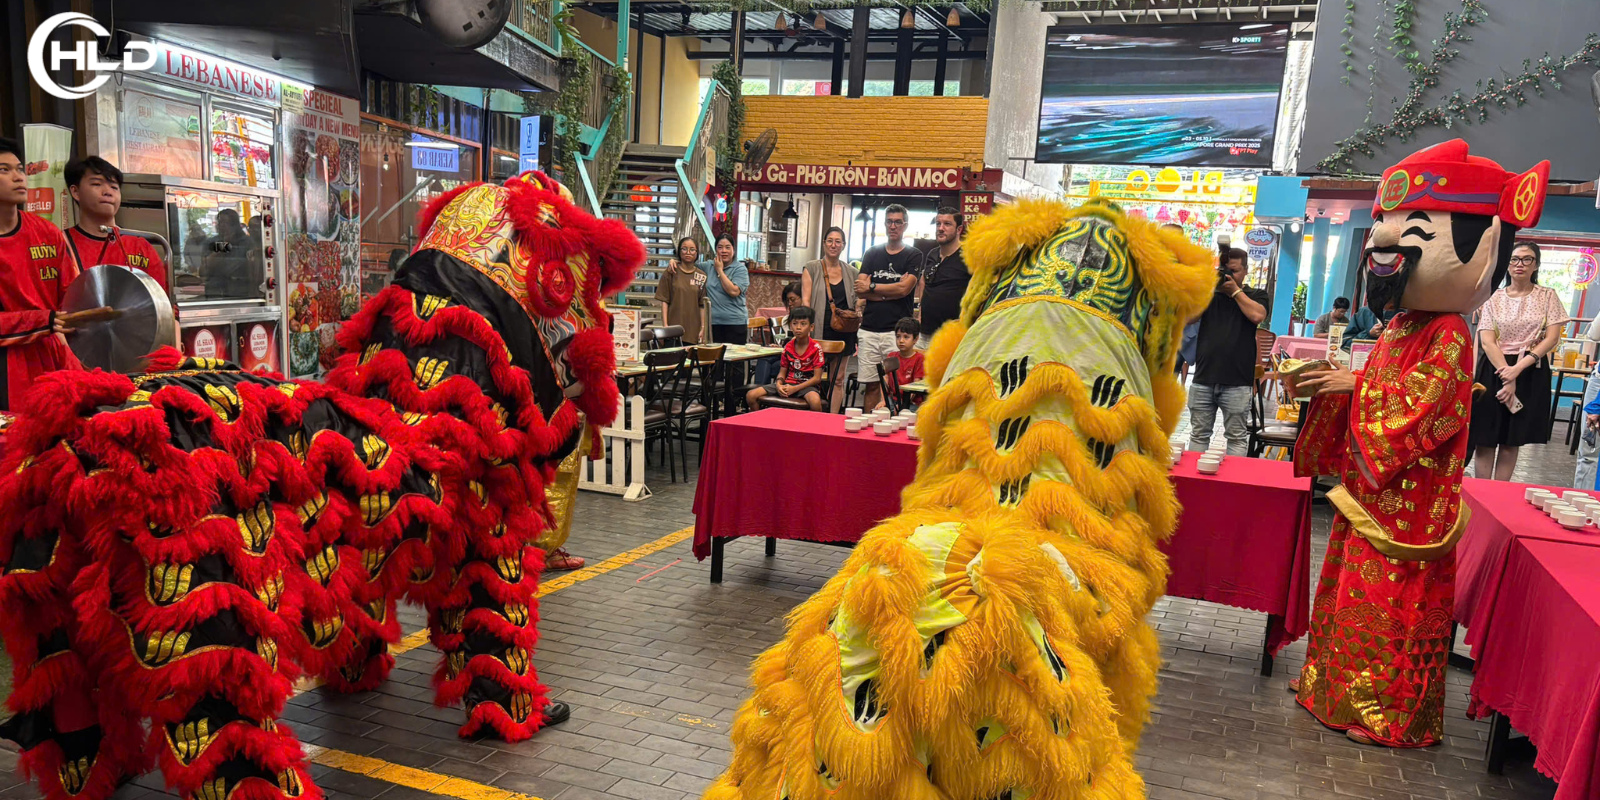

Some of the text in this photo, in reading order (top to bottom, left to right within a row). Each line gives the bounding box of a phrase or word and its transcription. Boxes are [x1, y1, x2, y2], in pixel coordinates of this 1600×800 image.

[164, 49, 276, 101] LEBANESE
[303, 88, 344, 116] SPECIEAL
[318, 116, 324, 131] A
[325, 118, 340, 135] NEW
[341, 122, 359, 139] MENU
